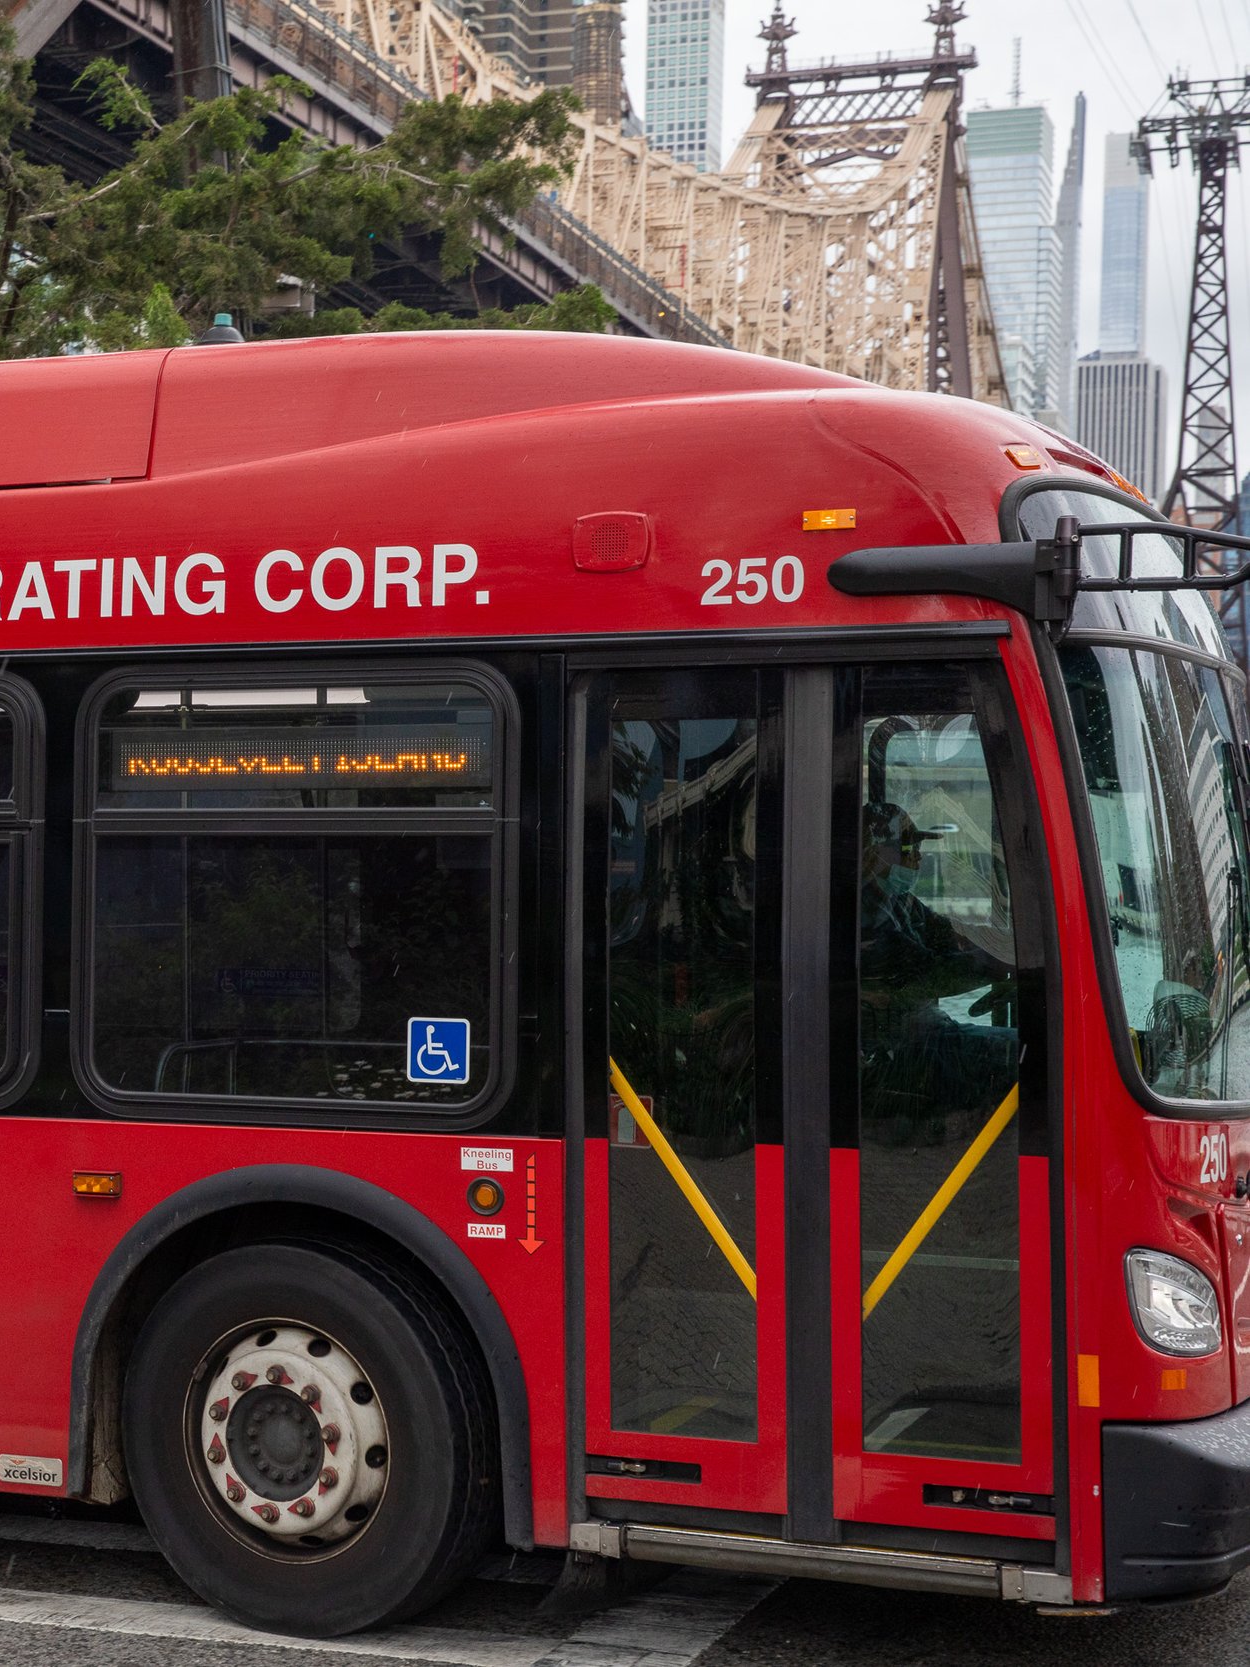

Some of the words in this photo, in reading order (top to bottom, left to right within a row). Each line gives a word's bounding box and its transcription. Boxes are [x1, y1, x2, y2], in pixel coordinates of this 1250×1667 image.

[255, 544, 489, 612] CORP.
[701, 556, 805, 605] 250
[462, 1149, 512, 1161] Kneeling
[1200, 1133, 1227, 1183] 250
[476, 1160, 498, 1170] Bus
[470, 1226, 504, 1237] RAMP
[4, 1467, 58, 1482] xcelsior
